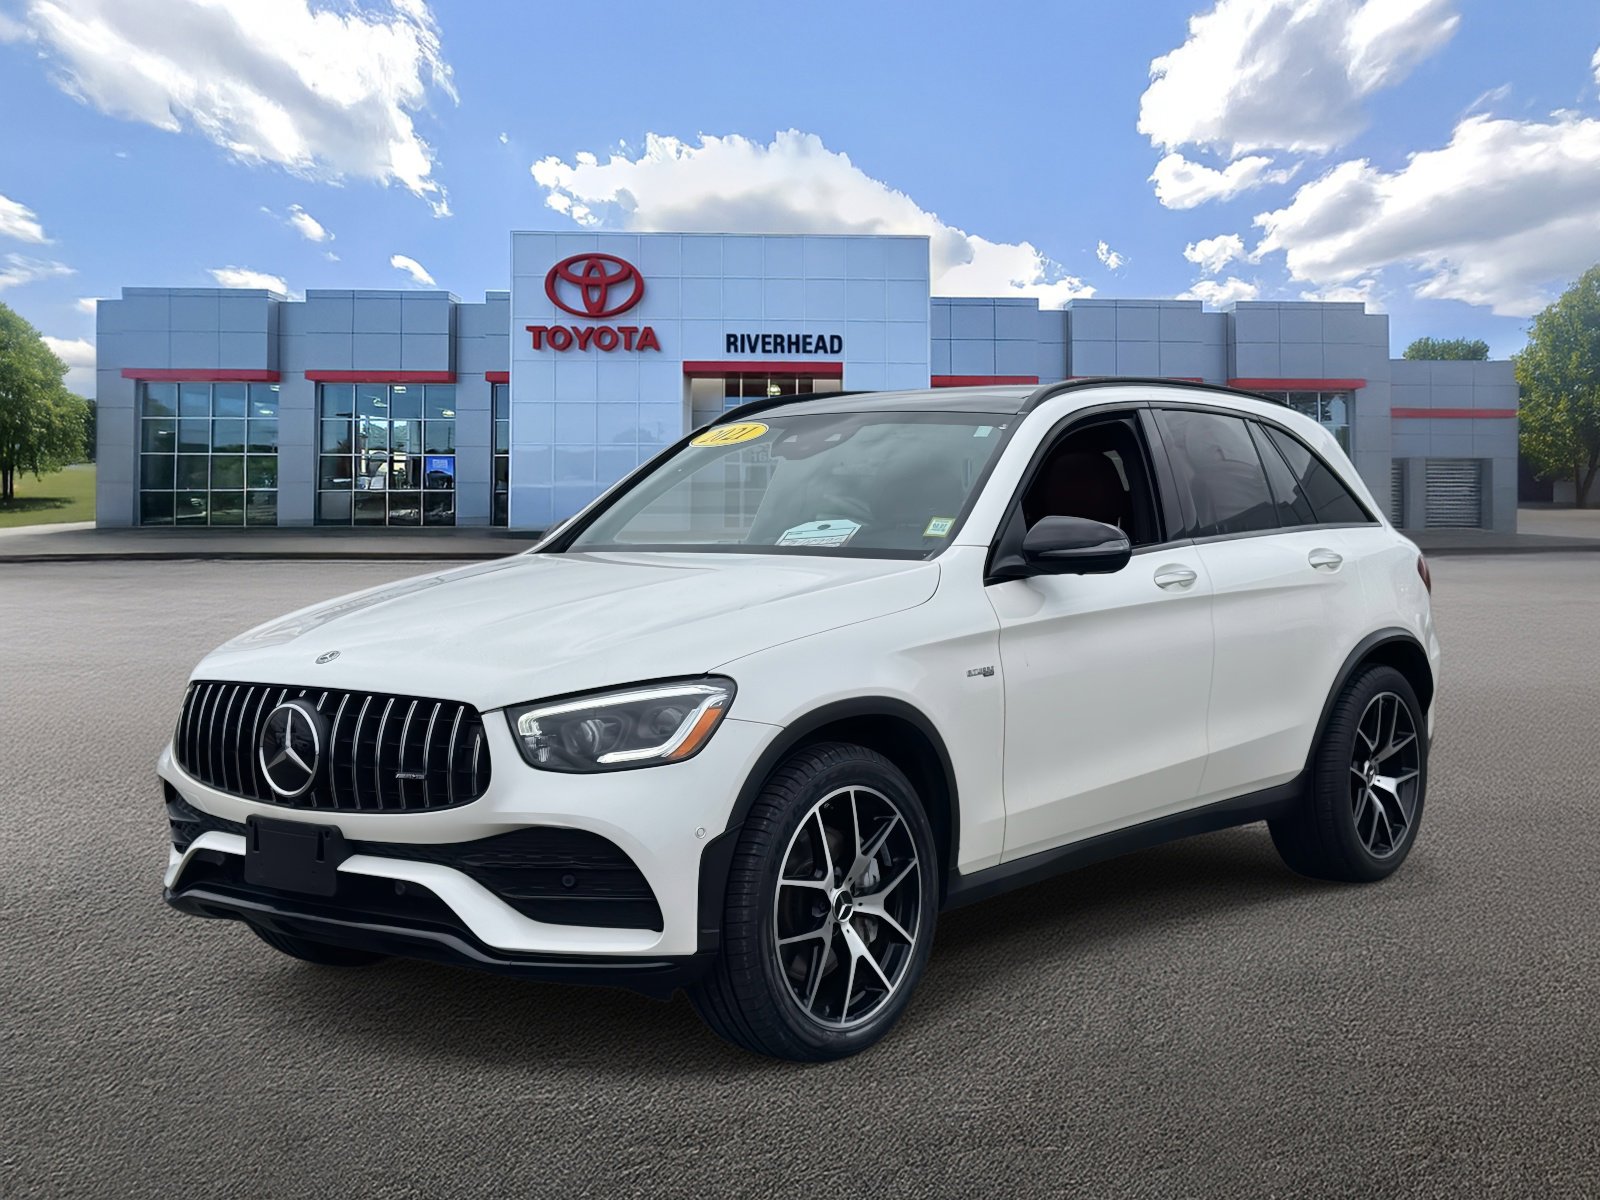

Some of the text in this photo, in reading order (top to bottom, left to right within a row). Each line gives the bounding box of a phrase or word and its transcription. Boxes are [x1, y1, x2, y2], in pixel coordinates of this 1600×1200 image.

[525, 325, 661, 352] TOYOTA
[725, 333, 843, 354] RIVERHEAD
[698, 425, 760, 444] 2021
